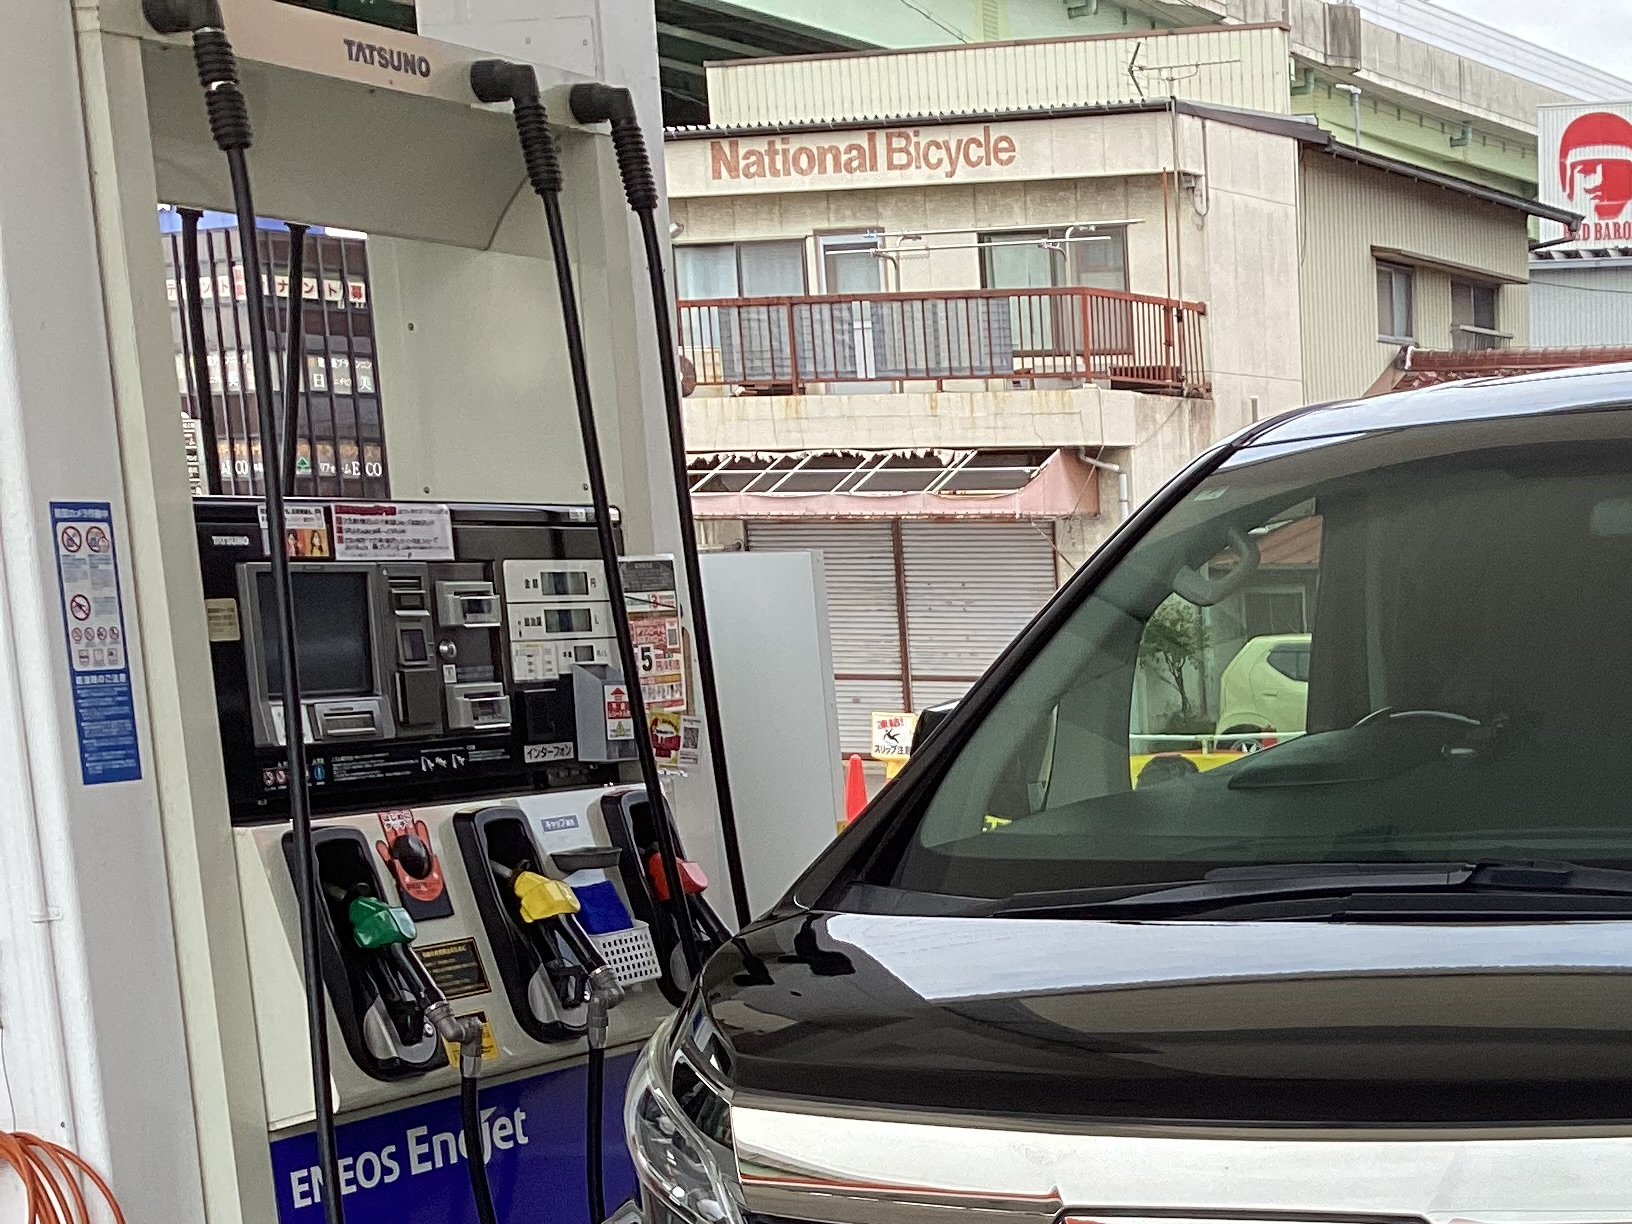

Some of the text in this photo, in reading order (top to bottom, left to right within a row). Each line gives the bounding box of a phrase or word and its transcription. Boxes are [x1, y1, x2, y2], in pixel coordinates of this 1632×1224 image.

[343, 38, 431, 78] TATSUNO
[710, 125, 1016, 180] National Bicycle
[641, 646, 653, 672] 5
[527, 744, 572, 760] インターフォン
